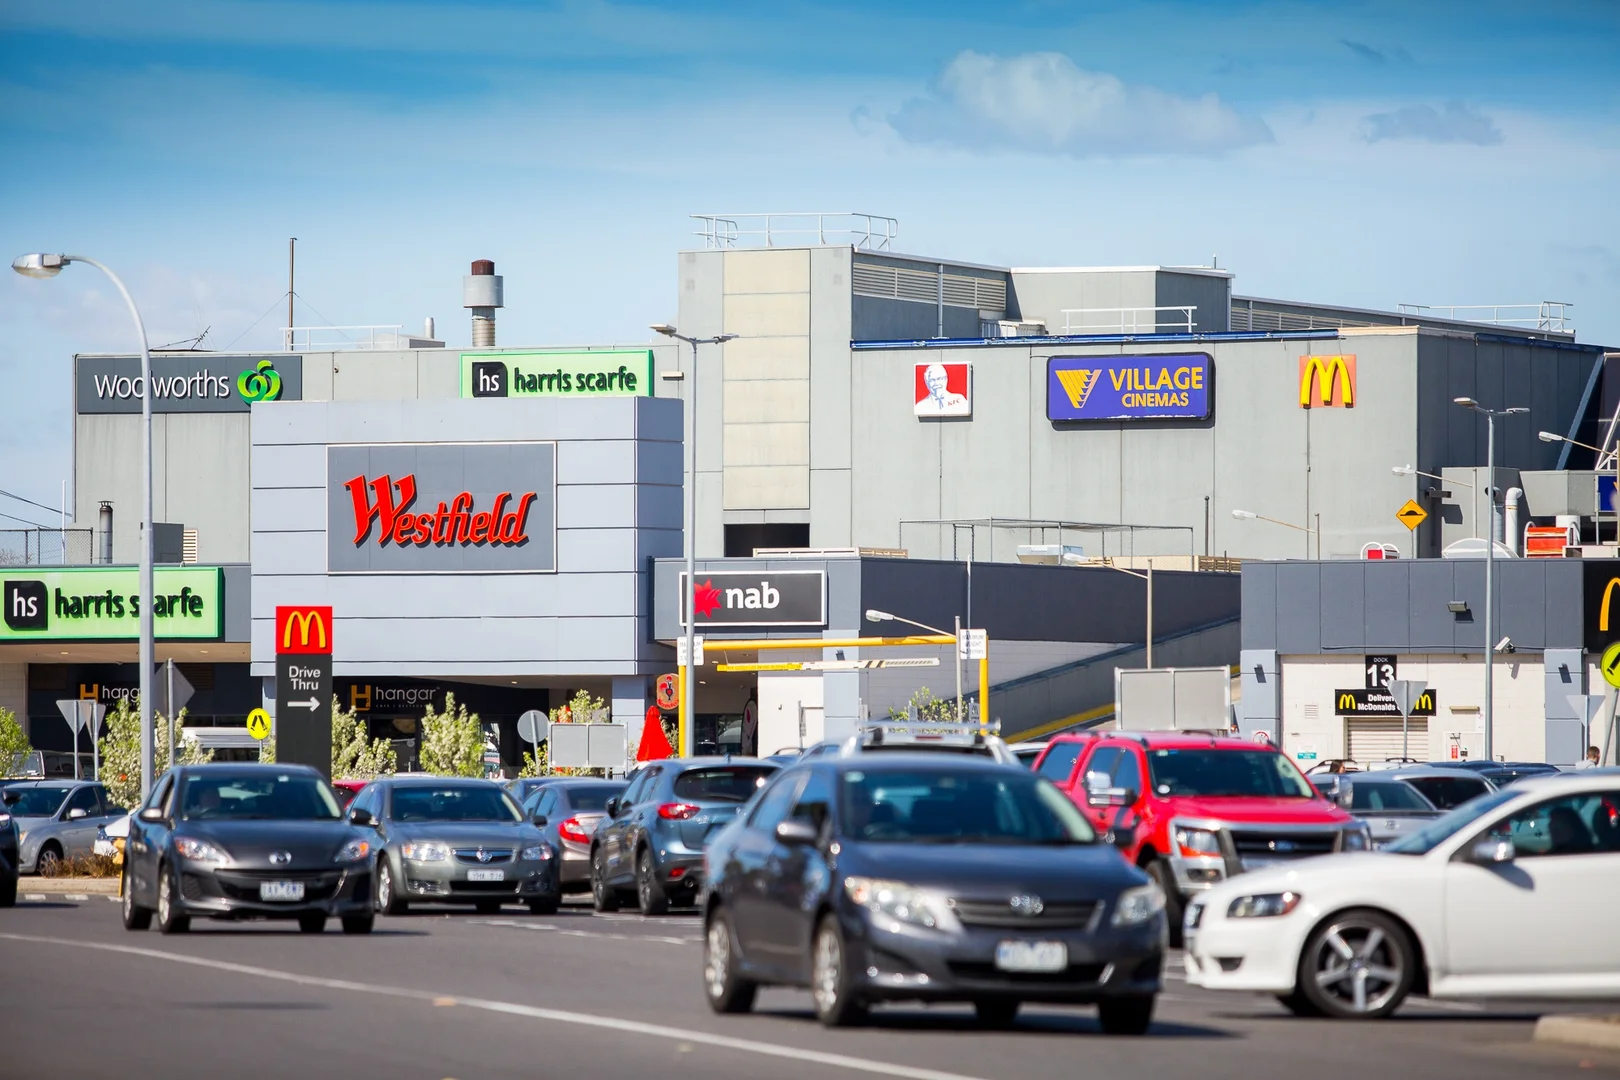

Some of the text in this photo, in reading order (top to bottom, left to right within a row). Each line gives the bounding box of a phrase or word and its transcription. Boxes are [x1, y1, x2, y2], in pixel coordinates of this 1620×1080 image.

[479, 366, 637, 393] hs harris scarfe
[1109, 367, 1203, 391] VILLAGE
[1121, 392, 1189, 408] CINEMAS
[343, 473, 537, 545] Westfield
[13, 586, 204, 617] hs harris sarfe
[726, 582, 780, 609] nab
[289, 665, 320, 679] Drive
[1367, 664, 1395, 687] 13
[102, 685, 141, 703] hang
[290, 678, 319, 691] Thru
[375, 686, 436, 704] hangar
[1357, 703, 1396, 711] McDonalds
